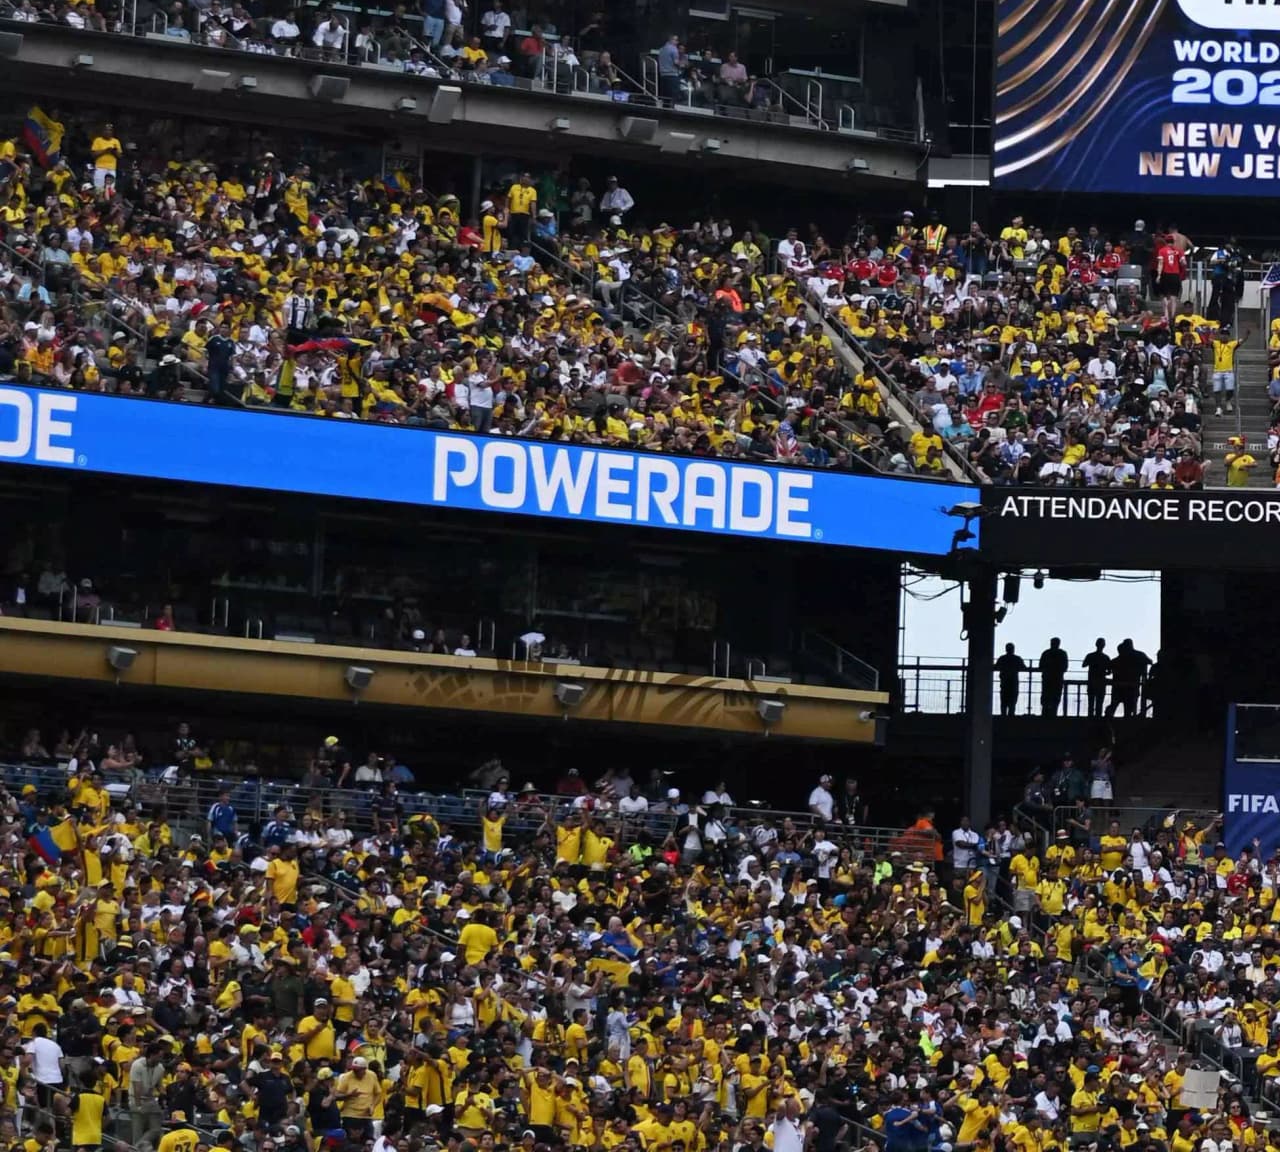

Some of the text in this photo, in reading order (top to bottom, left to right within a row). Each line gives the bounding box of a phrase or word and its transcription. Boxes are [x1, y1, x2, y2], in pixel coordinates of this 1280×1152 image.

[1174, 40, 1280, 64] WORLD
[1161, 122, 1243, 148] NEW
[1139, 152, 1221, 178] NEW
[1001, 496, 1179, 520] ATTENDANCE
[1228, 794, 1279, 813] FIFA
